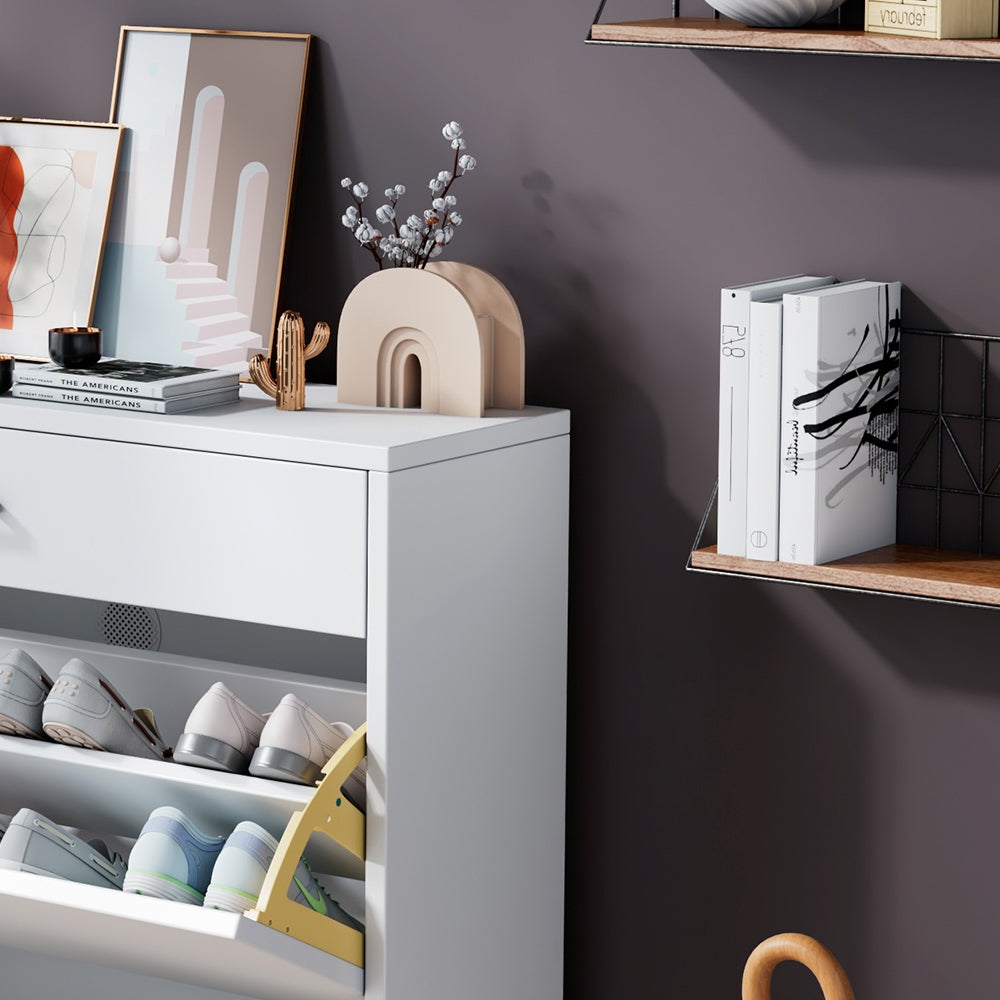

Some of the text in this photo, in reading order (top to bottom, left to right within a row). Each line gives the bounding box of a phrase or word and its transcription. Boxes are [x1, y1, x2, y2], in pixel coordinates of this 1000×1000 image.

[61, 379, 79, 387] THE
[82, 381, 139, 394] AMERICANS
[62, 393, 80, 401] THE
[83, 396, 142, 409] AMERICANS
